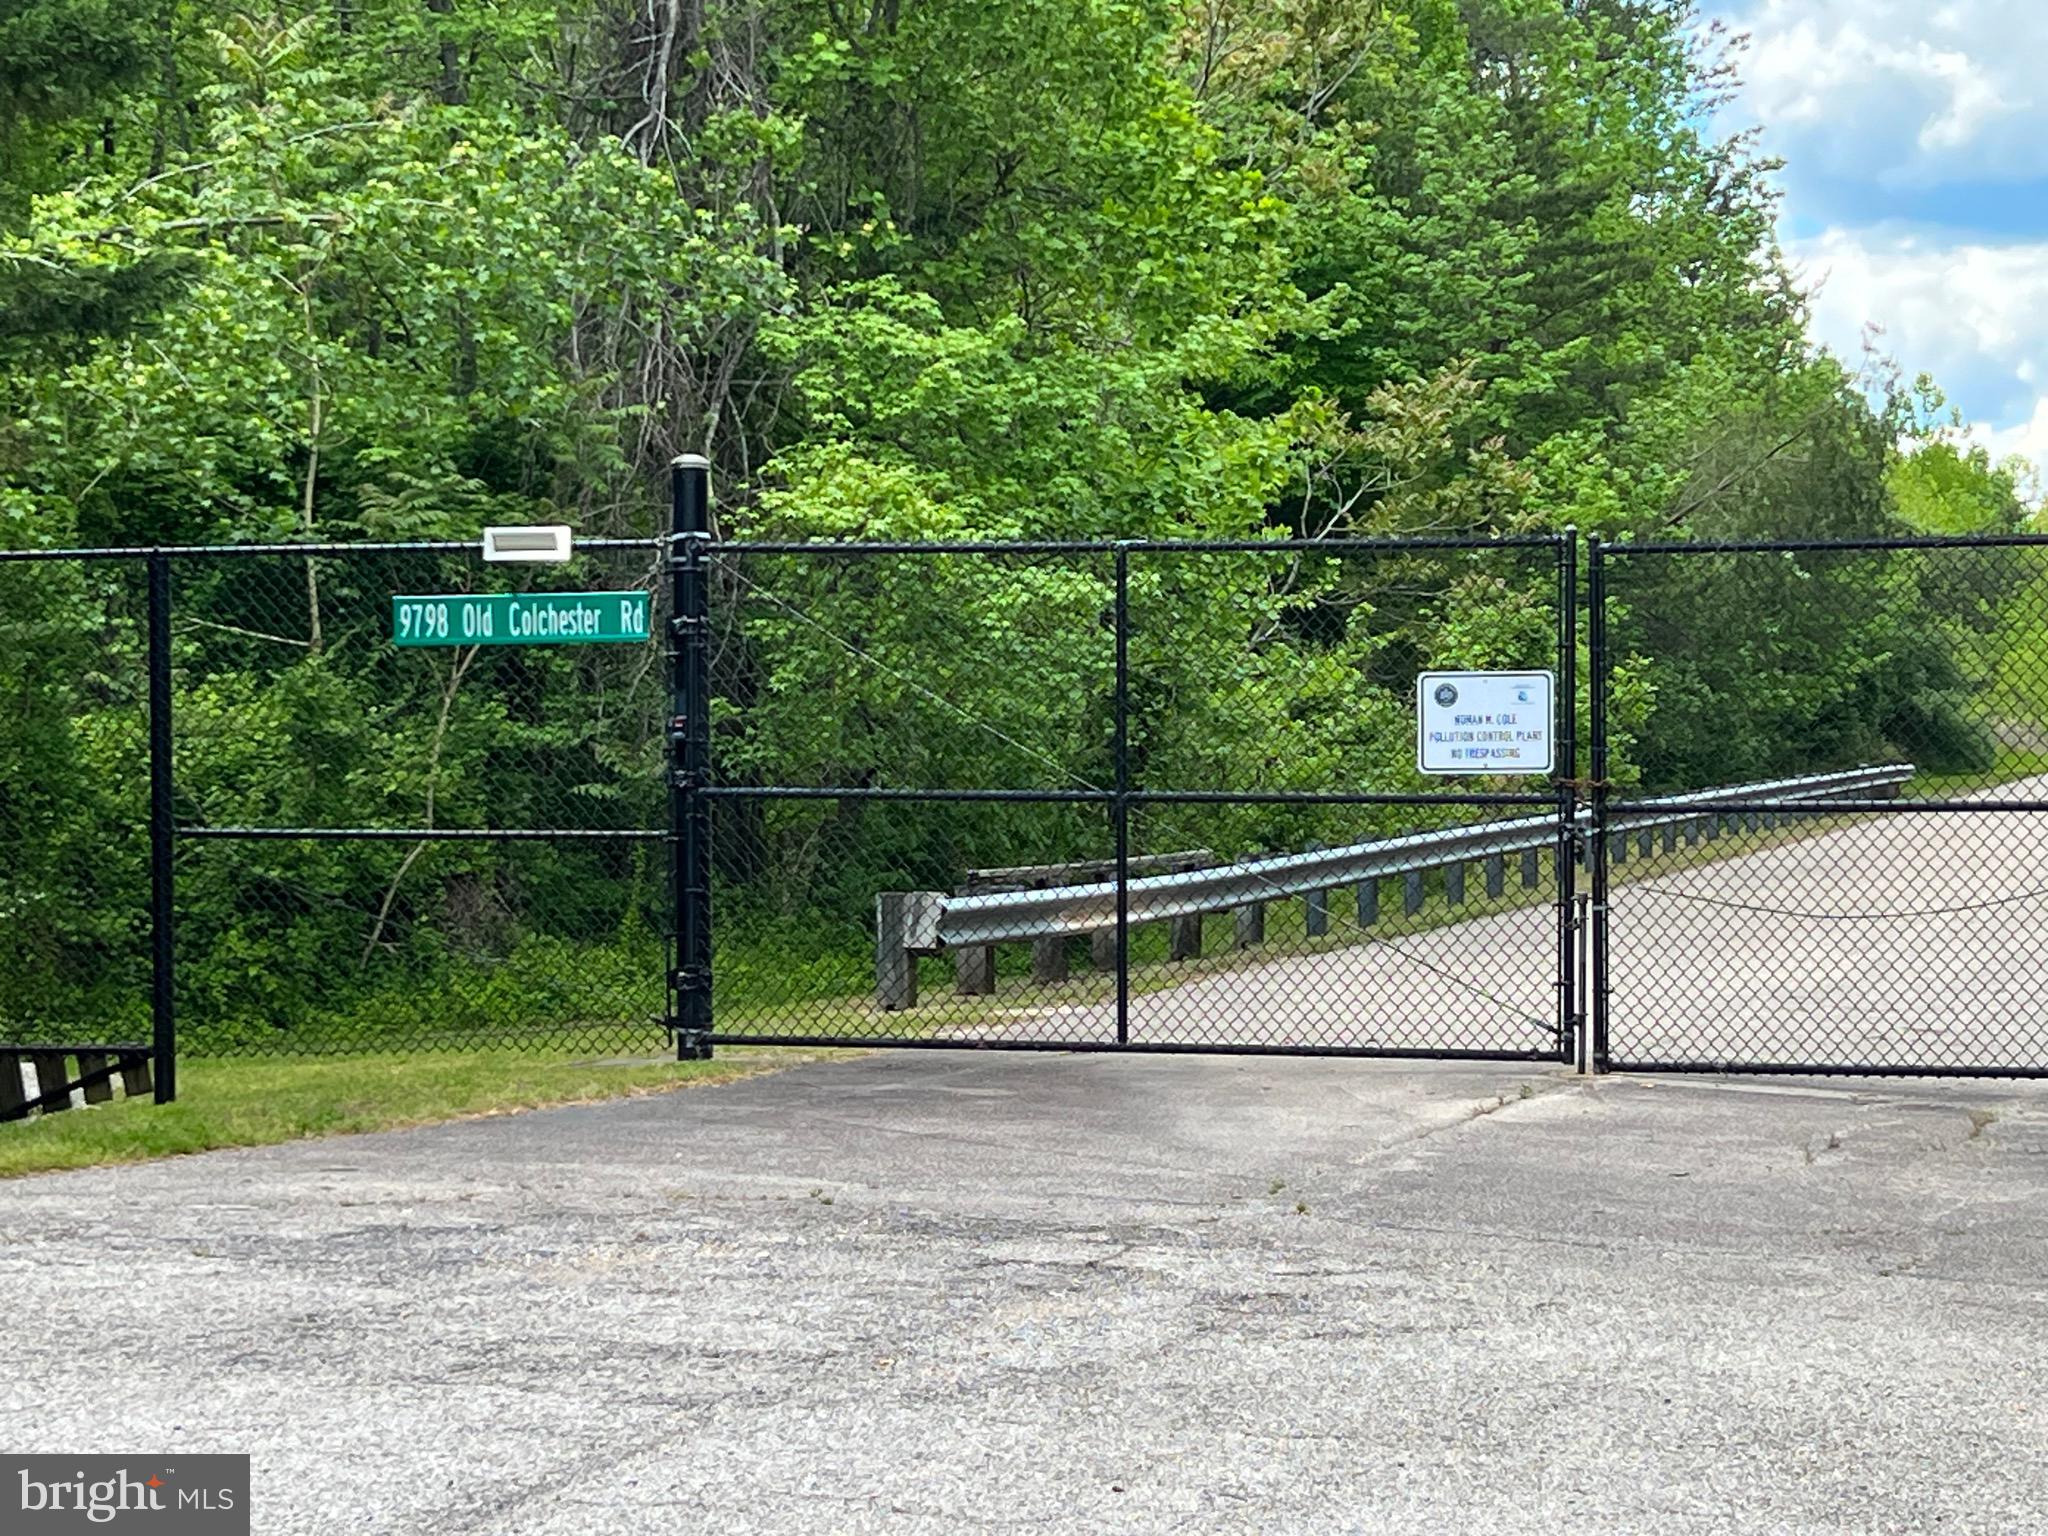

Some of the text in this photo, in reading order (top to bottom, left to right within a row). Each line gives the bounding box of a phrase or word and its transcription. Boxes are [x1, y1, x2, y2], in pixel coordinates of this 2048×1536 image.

[399, 599, 644, 638] 9798 Old Colchester Rd
[1496, 713, 1518, 725] COLE
[1429, 730, 1542, 742] POLLUTION CONTROL PLANT
[1451, 748, 1521, 759] NO TRESPASSING
